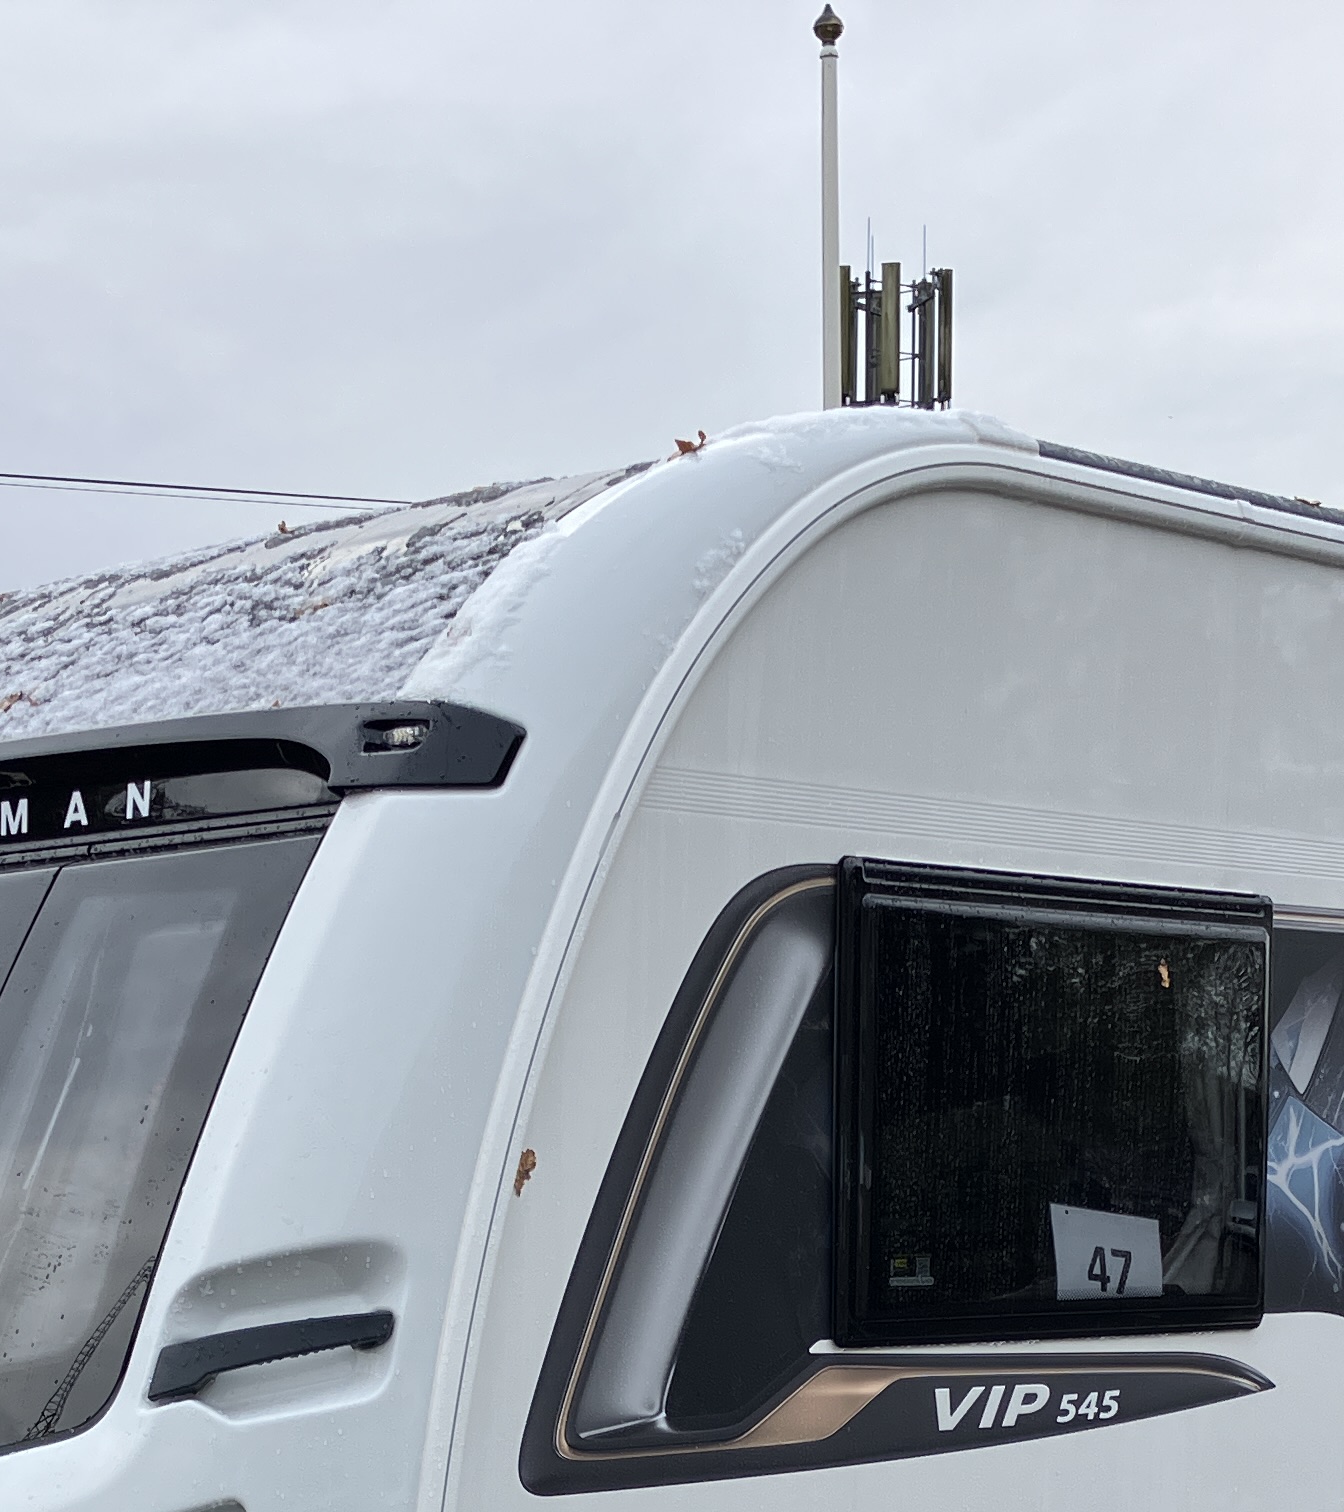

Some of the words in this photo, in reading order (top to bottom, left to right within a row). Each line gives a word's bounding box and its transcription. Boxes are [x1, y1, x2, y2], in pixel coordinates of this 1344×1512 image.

[1087, 1245, 1133, 1296] 47
[933, 1382, 1051, 1432] VIP
[1056, 1389, 1121, 1424] 545
